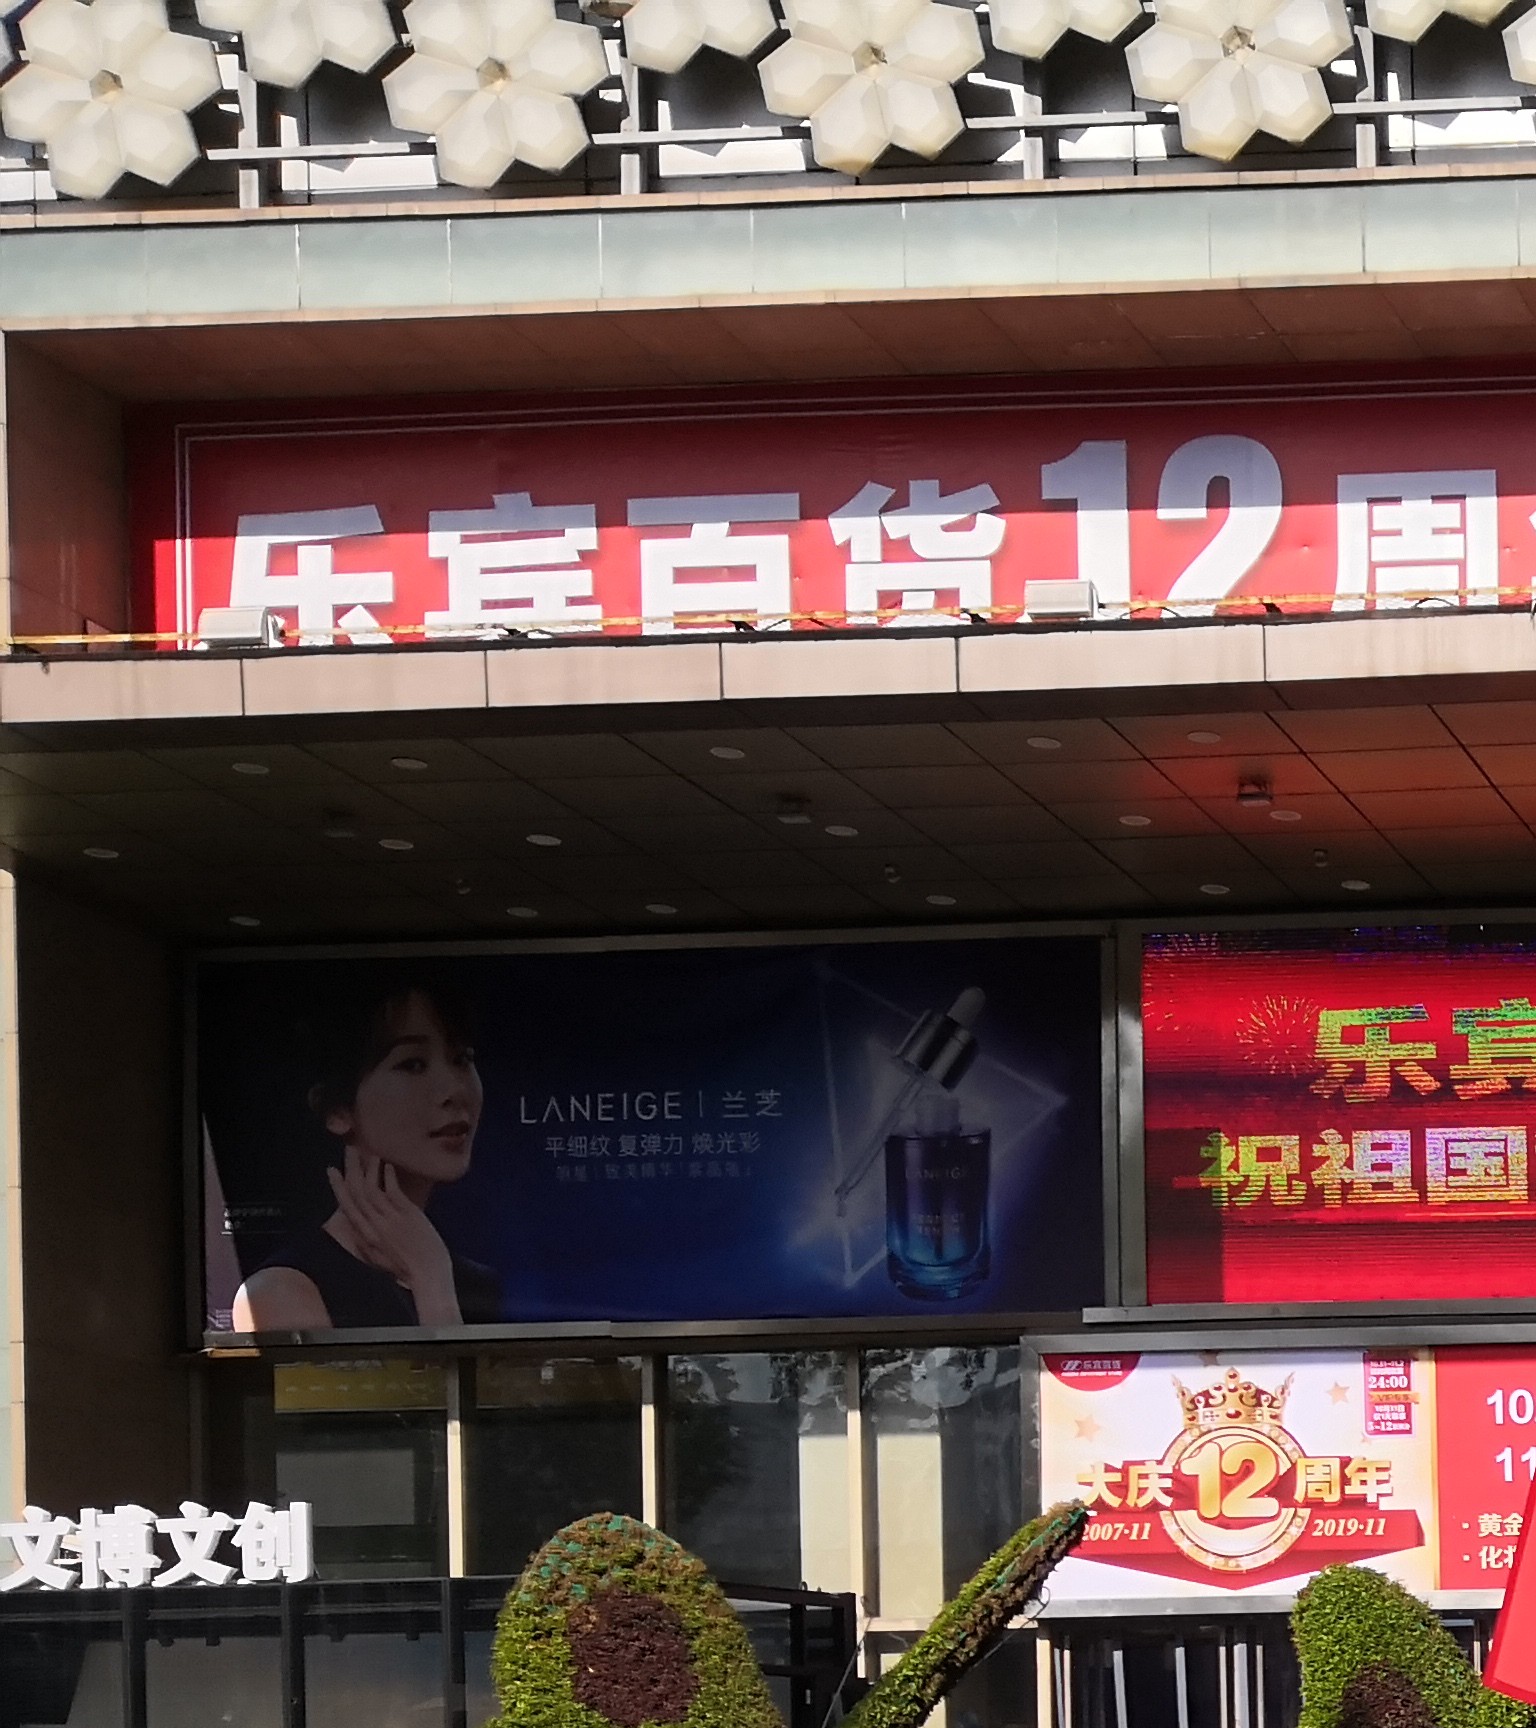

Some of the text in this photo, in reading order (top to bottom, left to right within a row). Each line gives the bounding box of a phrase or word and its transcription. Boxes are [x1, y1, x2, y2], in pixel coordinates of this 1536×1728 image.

[520, 1089, 783, 1124] LANEIGE 兰芝
[544, 1134, 611, 1159] 平细纹
[1075, 1440, 1393, 1519] 大庆12周年
[1478, 1512, 1524, 1538] 黄金
[0, 1501, 314, 1590] 文博文创
